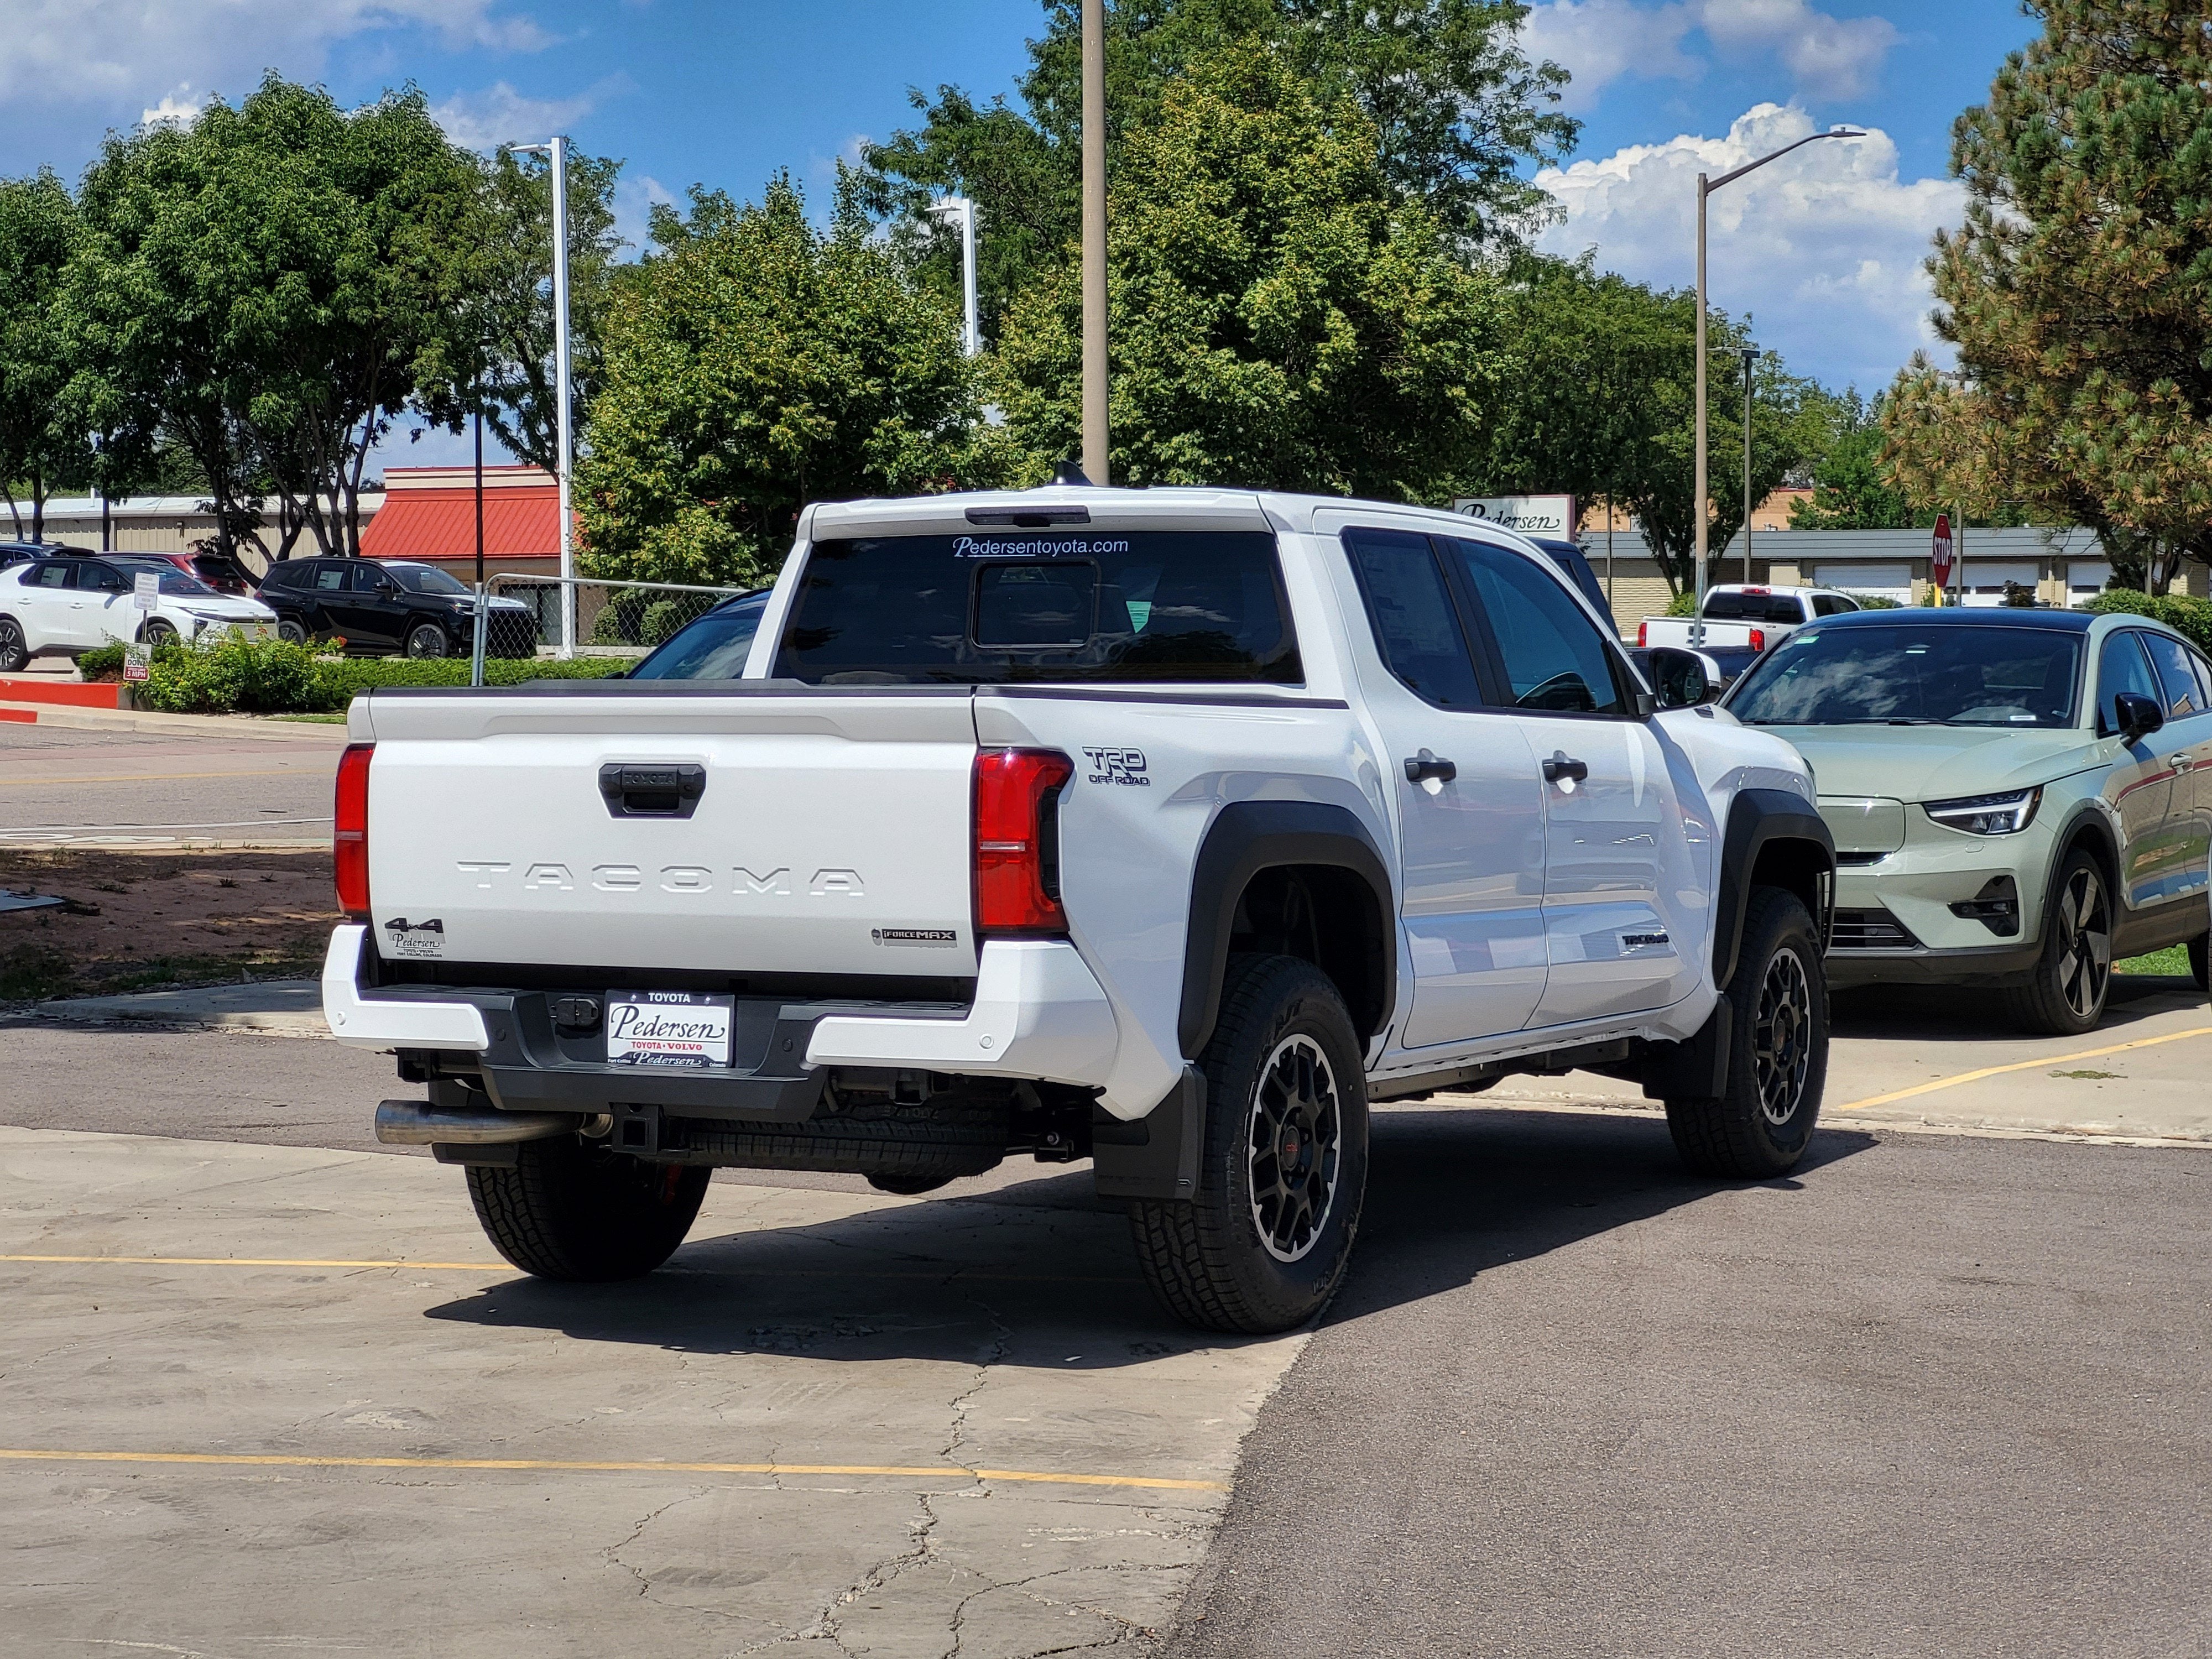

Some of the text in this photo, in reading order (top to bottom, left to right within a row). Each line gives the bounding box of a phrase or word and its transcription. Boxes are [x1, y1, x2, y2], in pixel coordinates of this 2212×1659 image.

[953, 537, 1128, 557] Pedersentoyota.com
[1934, 536, 1951, 566] STOP
[1082, 746, 1147, 778] TRD
[624, 773, 675, 784] TOYOTA
[1088, 774, 1150, 786] OFF ROAD
[457, 860, 864, 895] TACOMA
[392, 933, 440, 948] Pedersen
[648, 993, 691, 1003] TOYOTA
[611, 1005, 726, 1039] Pedersen
[632, 1041, 703, 1051] TOYOTA VOLVO
[633, 1050, 702, 1066] Pedersen
